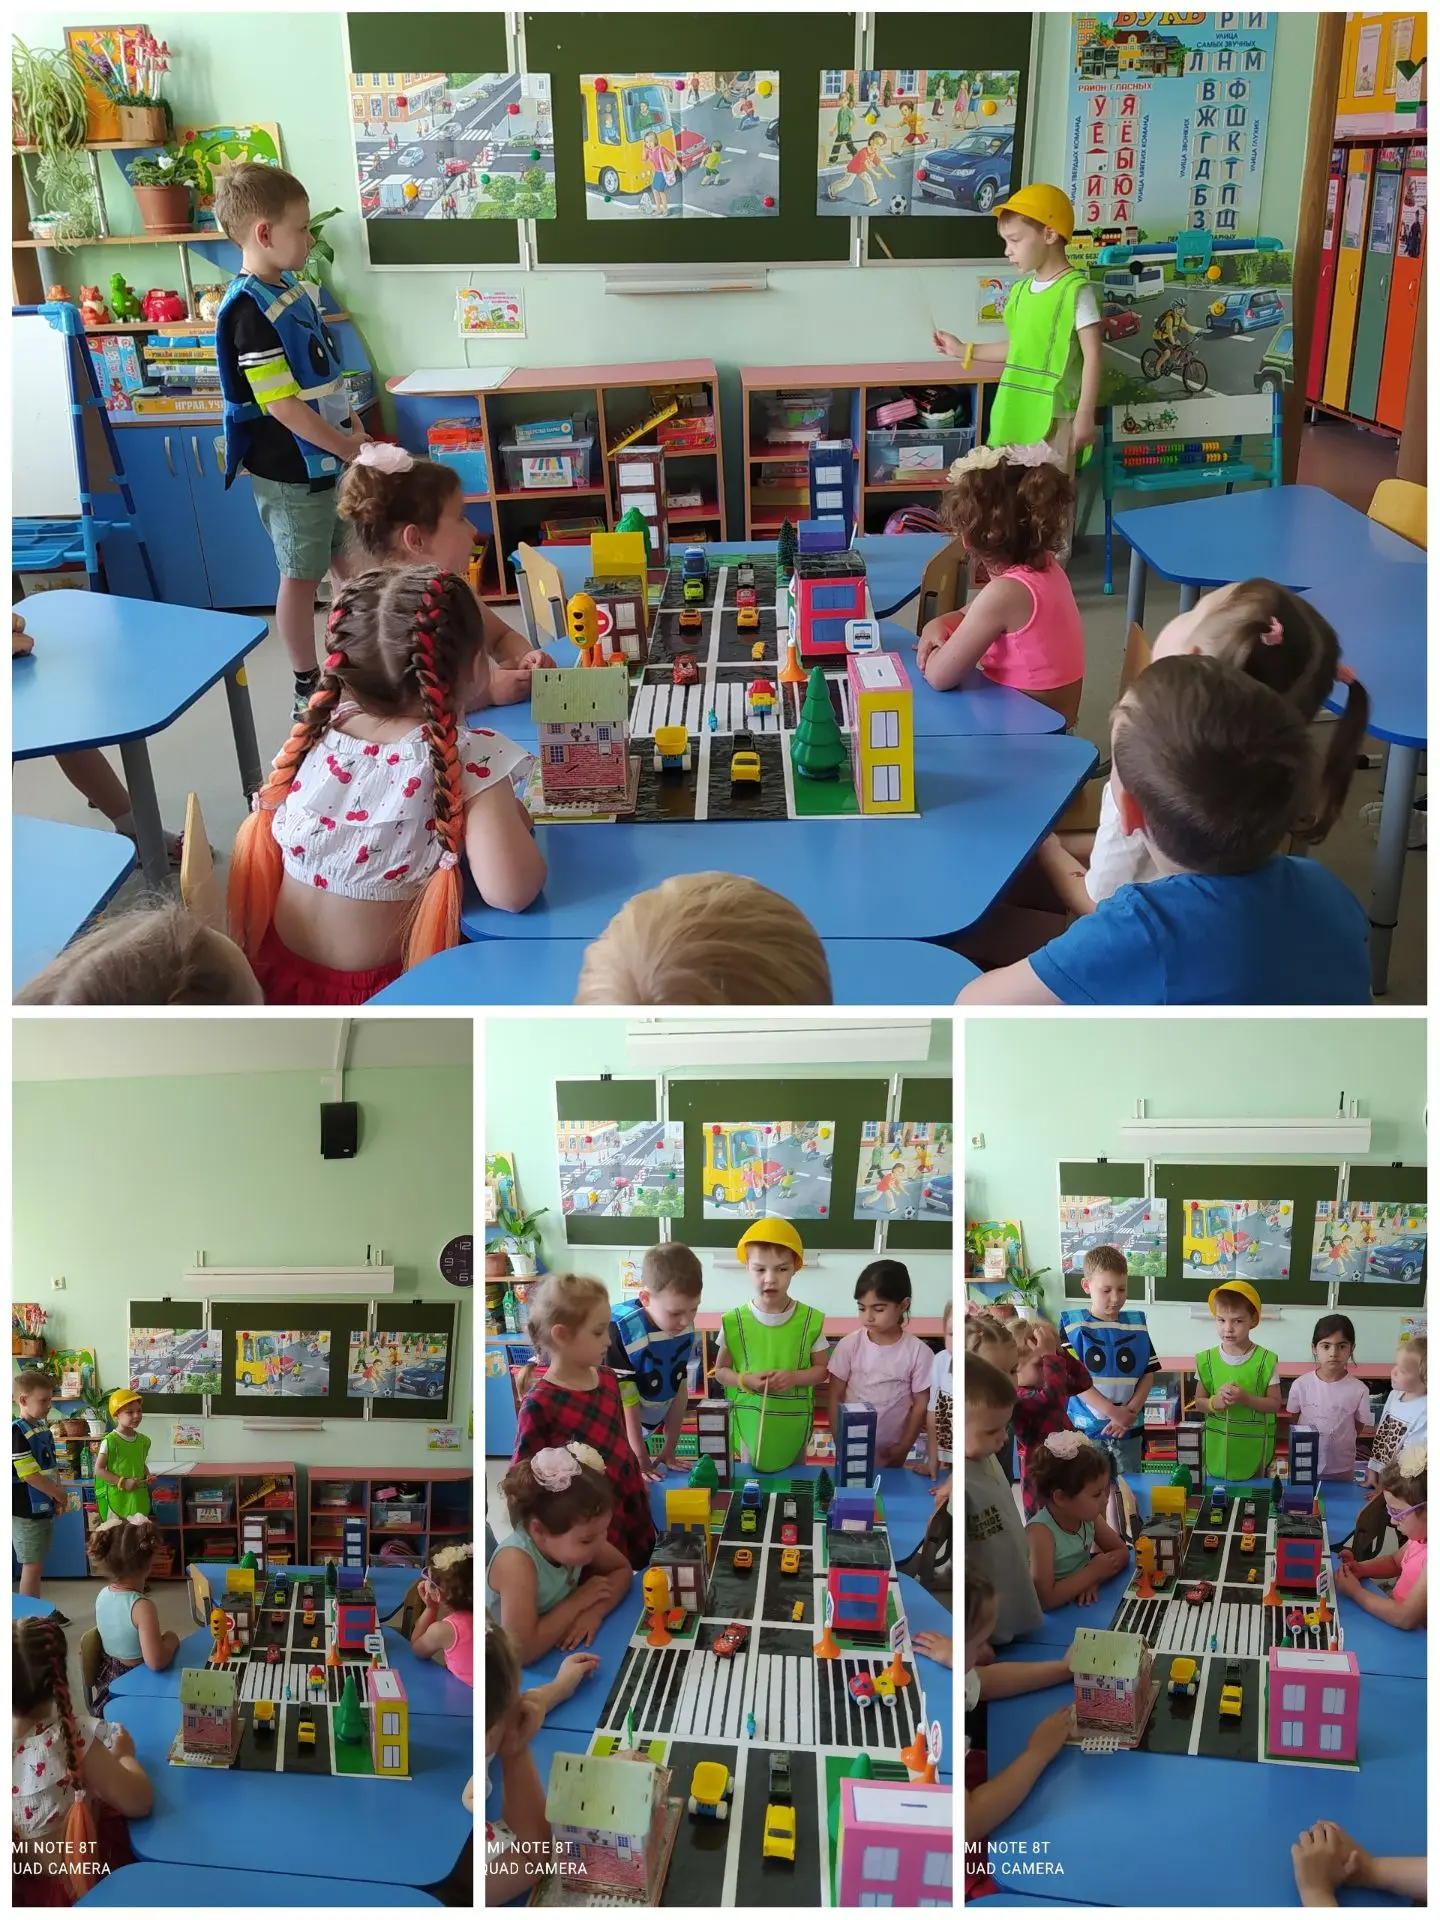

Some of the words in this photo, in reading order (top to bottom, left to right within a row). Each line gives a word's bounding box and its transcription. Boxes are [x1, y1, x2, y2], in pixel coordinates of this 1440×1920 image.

[1189, 52, 1203, 71] Л
[1218, 52, 1232, 70] Н
[1245, 52, 1262, 70] М
[1202, 81, 1216, 101] В
[1228, 80, 1246, 100] Ф
[1094, 97, 1107, 117] У
[1120, 97, 1136, 116] Я
[1197, 108, 1217, 127] Ж
[1227, 108, 1246, 126] Ш
[1073, 116, 1082, 149] КОМАНД
[1121, 120, 1132, 143] Ё
[1142, 114, 1150, 148] КОМАНД
[1181, 118, 1190, 152] ЗВОНКИХ
[1251, 119, 1260, 147] ГЛУХИХ
[1200, 136, 1212, 154] Г
[1228, 133, 1241, 152] К
[1117, 150, 1133, 170] Ы
[1180, 154, 1188, 178] УЛИЦА
[1195, 159, 1211, 181] Д
[1225, 161, 1238, 179] Т
[1249, 148, 1257, 172] УЛИЦА
[1113, 177, 1133, 196] Ю
[1194, 188, 1207, 206] Б
[1222, 187, 1236, 205] П
[1087, 203, 1100, 222] Э
[1113, 203, 1127, 221] А
[1193, 211, 1206, 229] З
